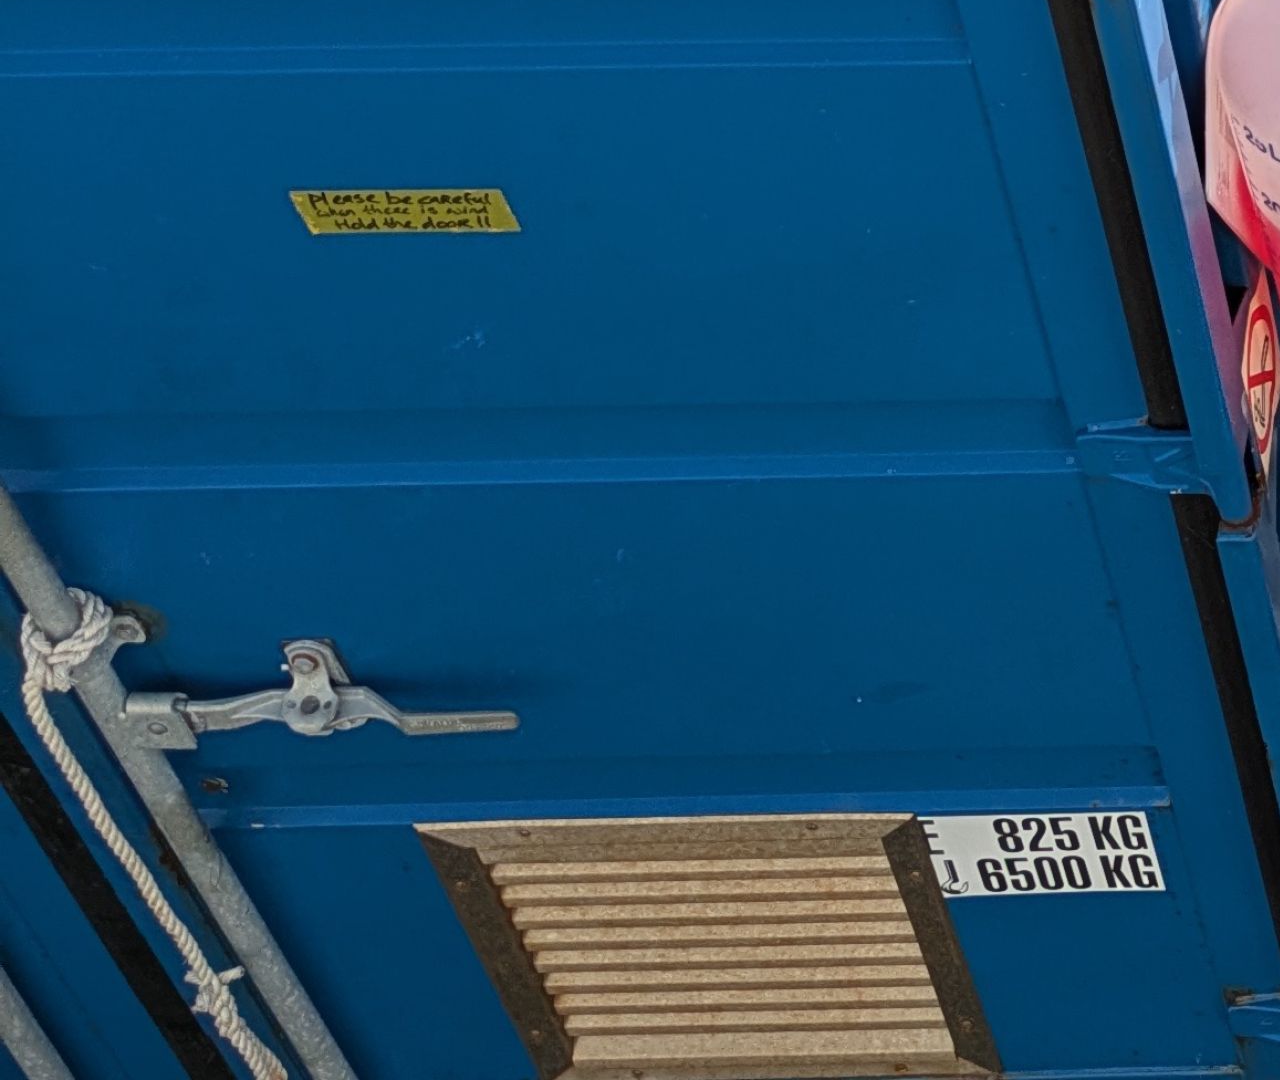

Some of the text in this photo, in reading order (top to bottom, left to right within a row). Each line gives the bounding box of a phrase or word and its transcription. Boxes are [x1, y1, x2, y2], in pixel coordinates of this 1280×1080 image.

[385, 191, 414, 205] be
[335, 216, 380, 231] Hold
[383, 217, 418, 230] the
[992, 817, 1081, 853] 825
[1088, 814, 1149, 851] KG
[976, 854, 1160, 893] 6500 KG
